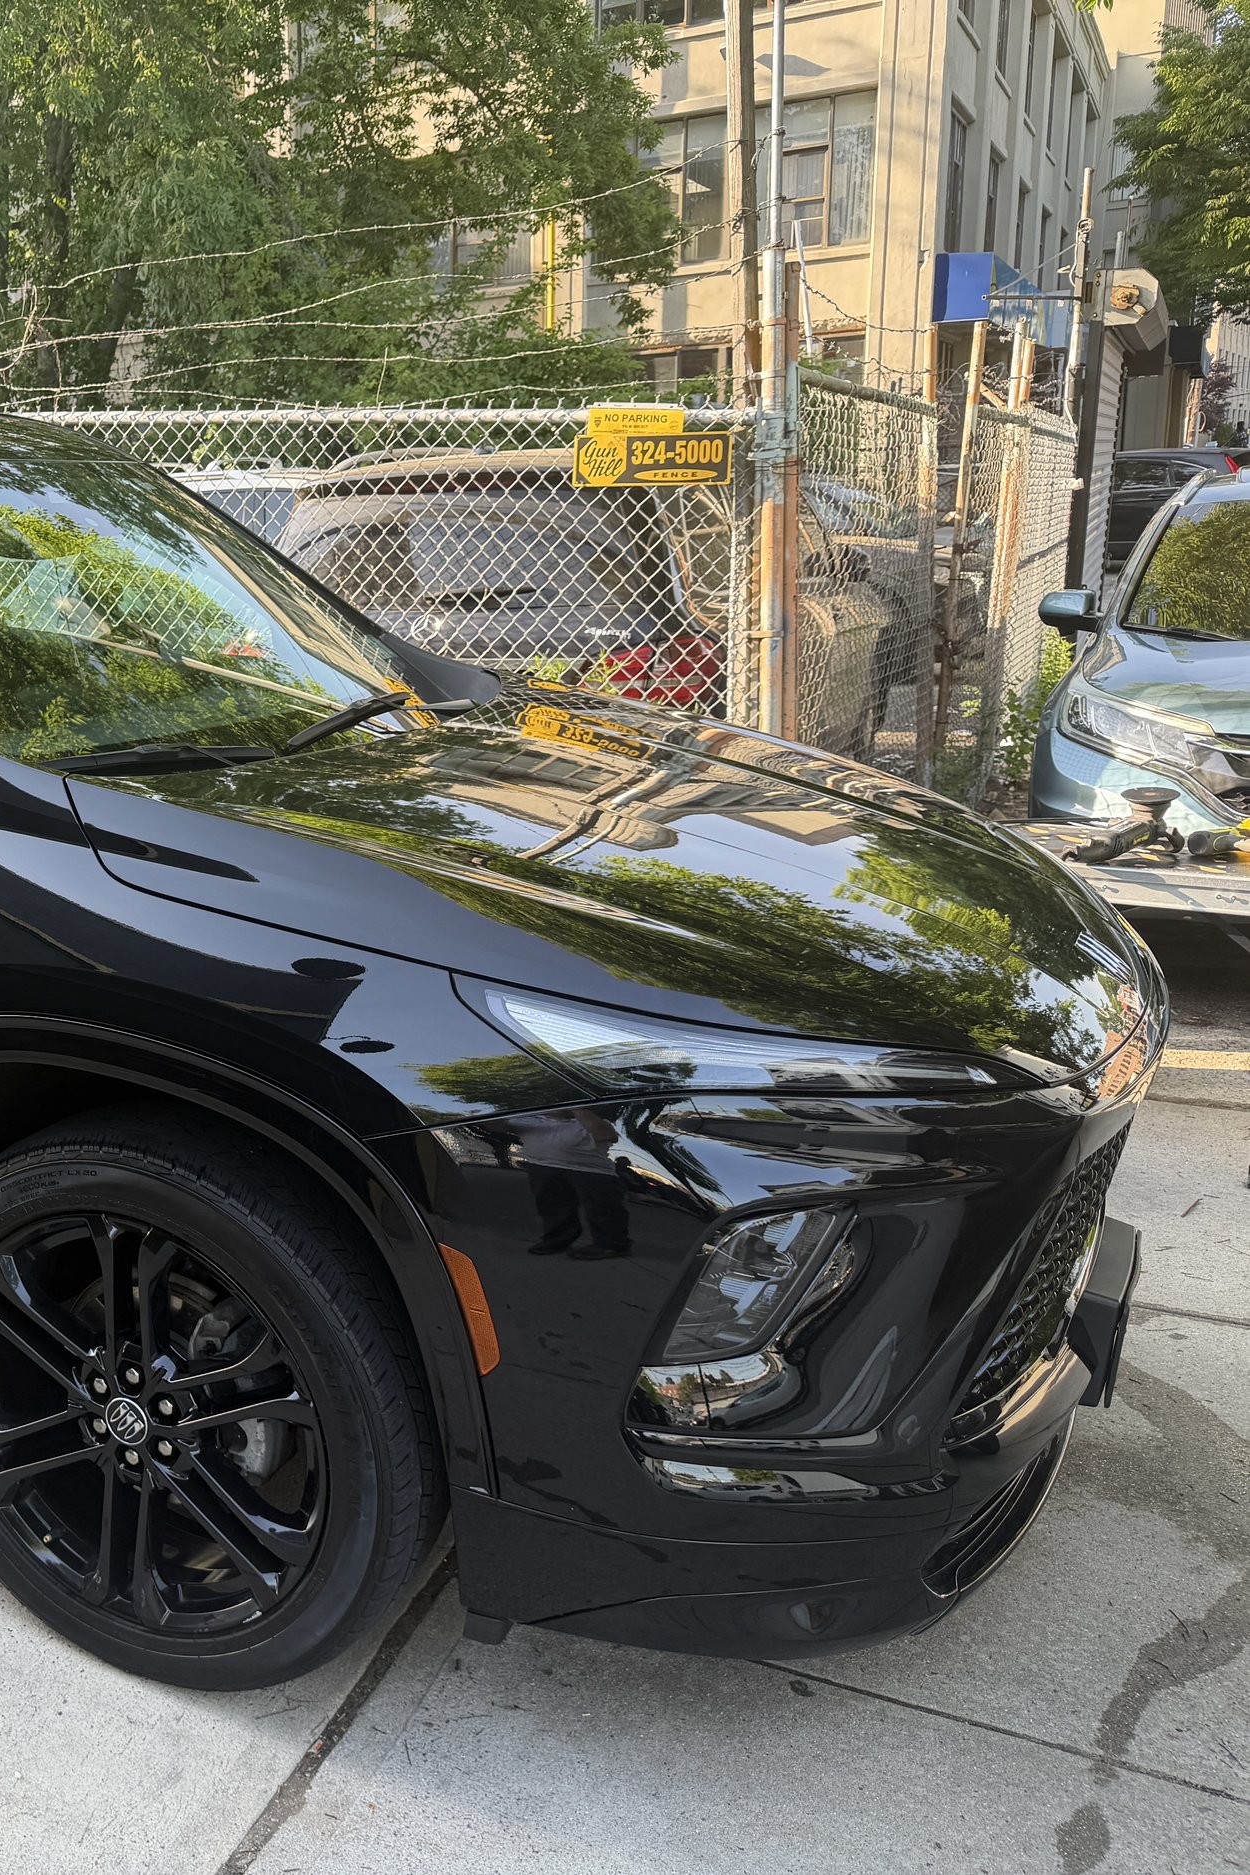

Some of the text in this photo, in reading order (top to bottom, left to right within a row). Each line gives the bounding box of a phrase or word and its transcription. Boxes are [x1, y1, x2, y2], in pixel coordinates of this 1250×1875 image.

[604, 414, 668, 423] NO PARKING
[583, 440, 619, 466] Gun
[631, 438, 724, 466] 324-5000
[588, 458, 623, 478] Hill
[653, 471, 699, 479] FENCE
